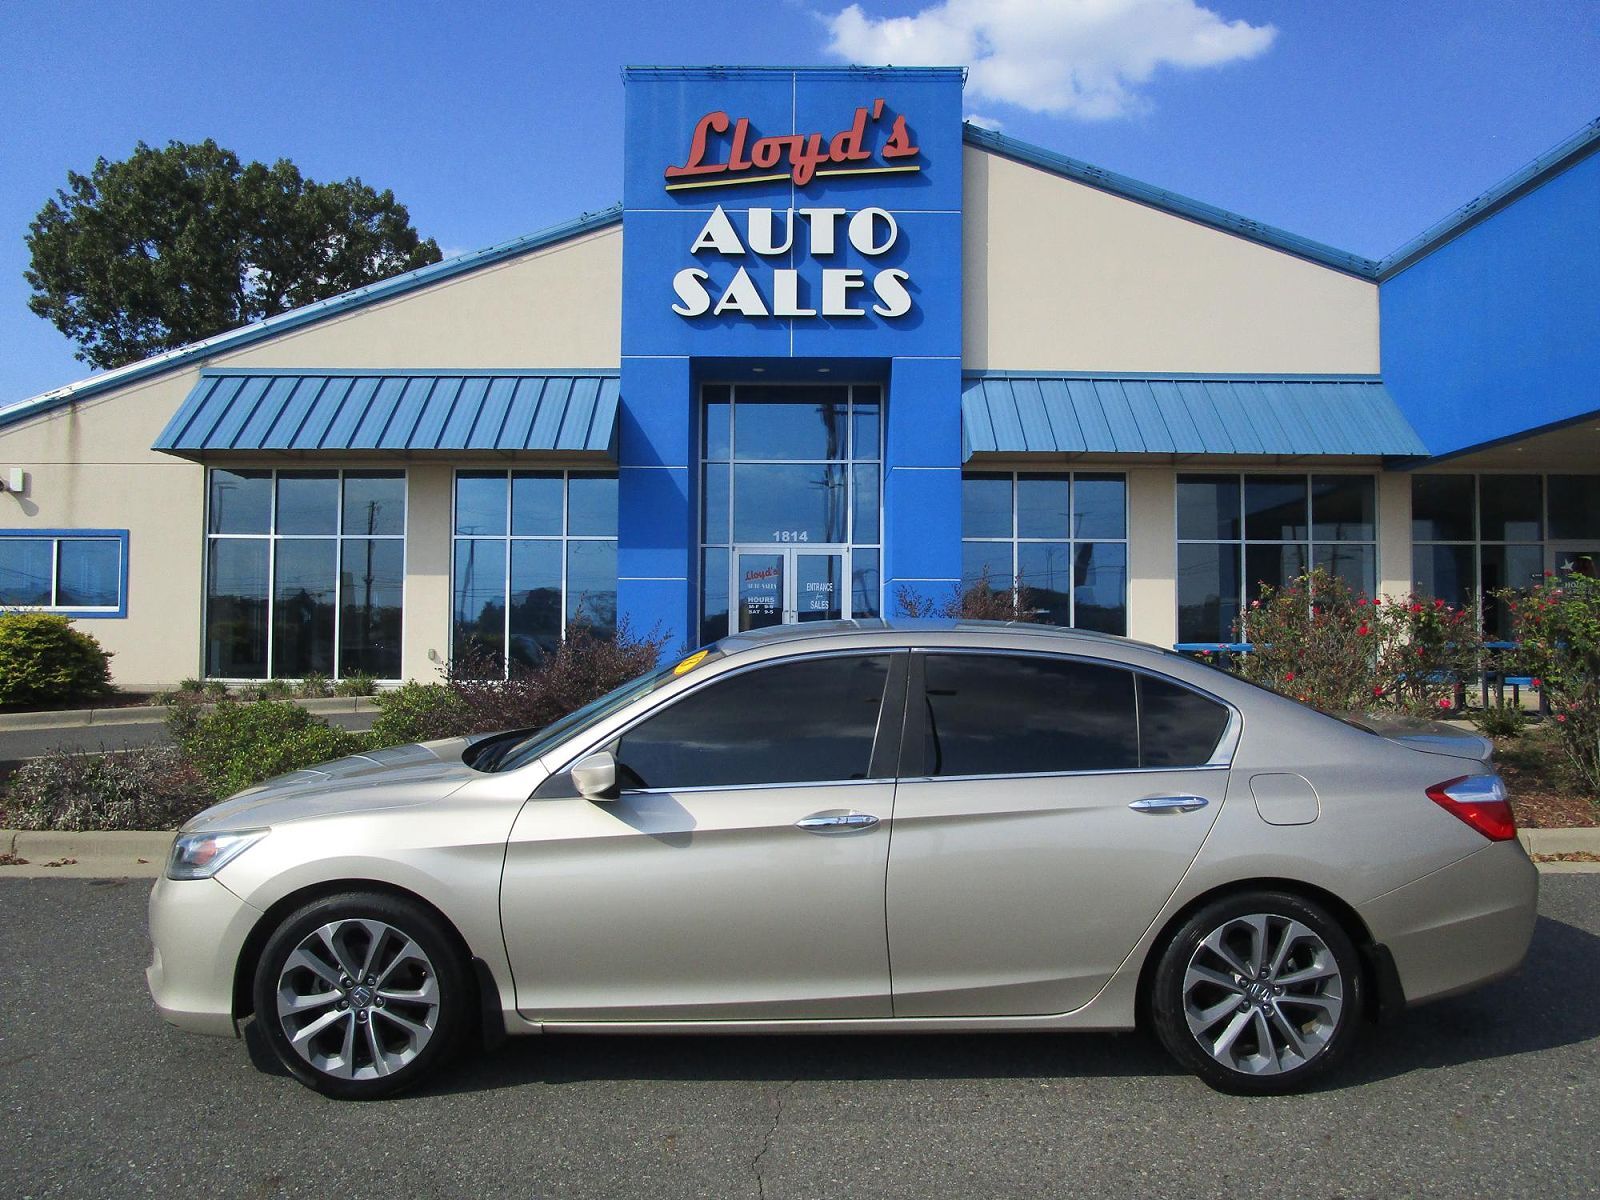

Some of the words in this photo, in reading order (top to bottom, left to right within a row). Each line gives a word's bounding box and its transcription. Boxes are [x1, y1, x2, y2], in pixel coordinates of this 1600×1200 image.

[664, 98, 920, 186] Lloyd's
[690, 204, 898, 256] AUTO
[671, 265, 912, 317] SALES
[772, 530, 808, 542] 1814
[806, 582, 833, 592] ENTRANCE
[810, 600, 829, 610] SALES
